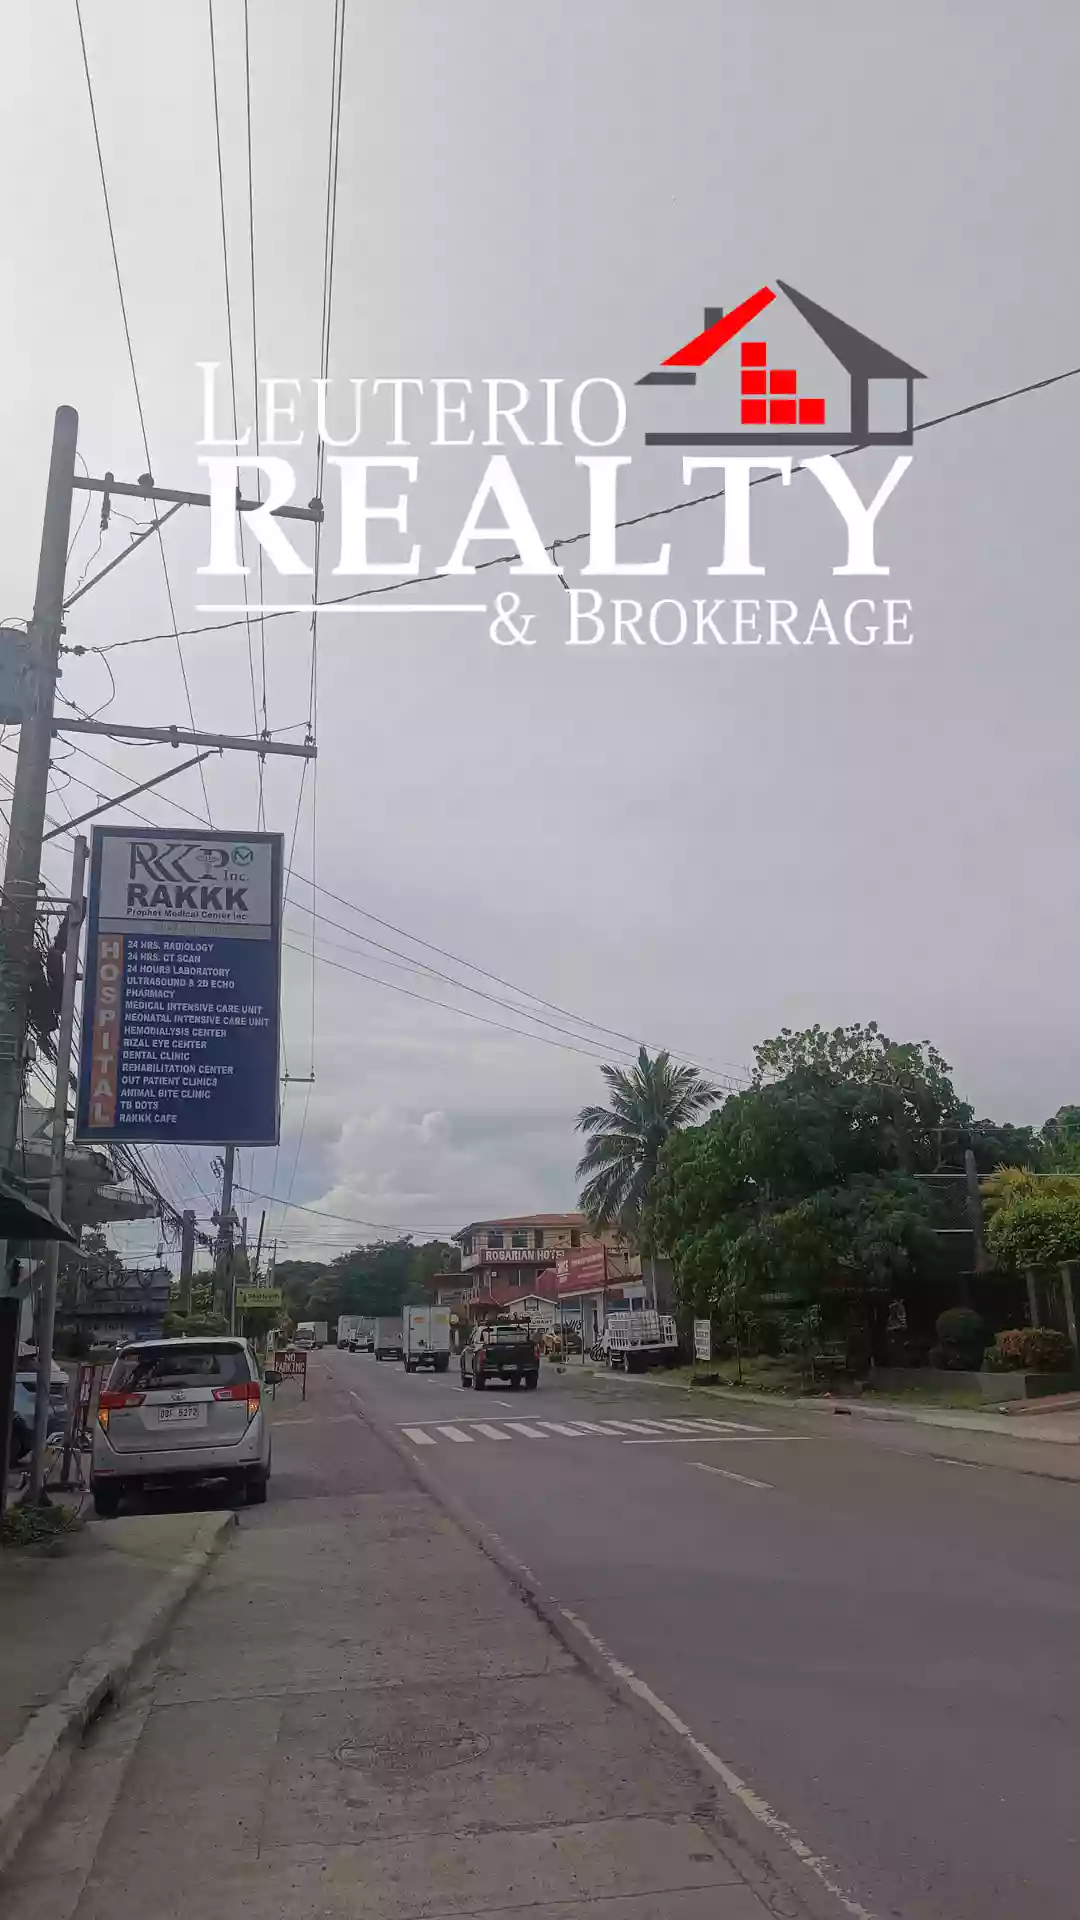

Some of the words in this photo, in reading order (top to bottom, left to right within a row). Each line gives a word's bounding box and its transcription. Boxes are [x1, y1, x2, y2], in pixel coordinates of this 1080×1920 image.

[127, 883, 249, 911] RAKKK
[127, 907, 161, 917] Prophet
[164, 909, 198, 918] Medical
[202, 910, 230, 919] Center
[128, 940, 138, 949] 24
[164, 941, 214, 952] RADIOLOGY
[128, 952, 138, 960] 24
[163, 953, 175, 962] CT
[177, 954, 201, 962] SCAN
[127, 964, 138, 973] 24
[140, 965, 170, 974] HOURS
[173, 966, 230, 977] LABORATORY
[127, 977, 186, 987] ULTRASOUND
[198, 979, 208, 988] 2D
[211, 980, 235, 989] ECHO
[126, 988, 175, 998] PHARMACY
[126, 1000, 164, 1010] MEDICAL
[167, 1002, 214, 1012] INTENSIVE
[216, 1004, 240, 1013] CARE
[242, 1005, 263, 1014] UNIT
[124, 1013, 172, 1023] NEONATAL
[174, 1015, 221, 1025] INTENSIVE
[223, 1016, 246, 1026] CARE
[248, 1018, 270, 1027] UNIT
[93, 941, 120, 1122] HOSPITAL
[124, 1026, 190, 1036] HEMODIALYSIS
[192, 1028, 227, 1038] CENTER
[123, 1038, 149, 1047] RIZAL
[152, 1039, 170, 1048] EYE
[172, 1040, 208, 1049] CENTER
[122, 1050, 157, 1060] DENTAL
[160, 1052, 190, 1061] CLINIC
[122, 1063, 196, 1073] REHABILITATION
[198, 1065, 234, 1075] CENTER
[121, 1076, 140, 1084] OUT
[143, 1076, 180, 1086] PATIENT
[182, 1077, 218, 1087] CLINICS
[120, 1088, 156, 1098] ANIMAL
[158, 1089, 178, 1098] BITE
[180, 1090, 212, 1099] CLINIC
[120, 1101, 132, 1109] TB
[135, 1101, 159, 1110] DOTS
[120, 1114, 152, 1123] RAKKK
[154, 1114, 178, 1123] CAFE
[486, 1250, 534, 1261] ROSARIAN
[536, 1249, 565, 1260] HOTE
[285, 1354, 296, 1362] NO
[276, 1362, 305, 1373] PARKING
